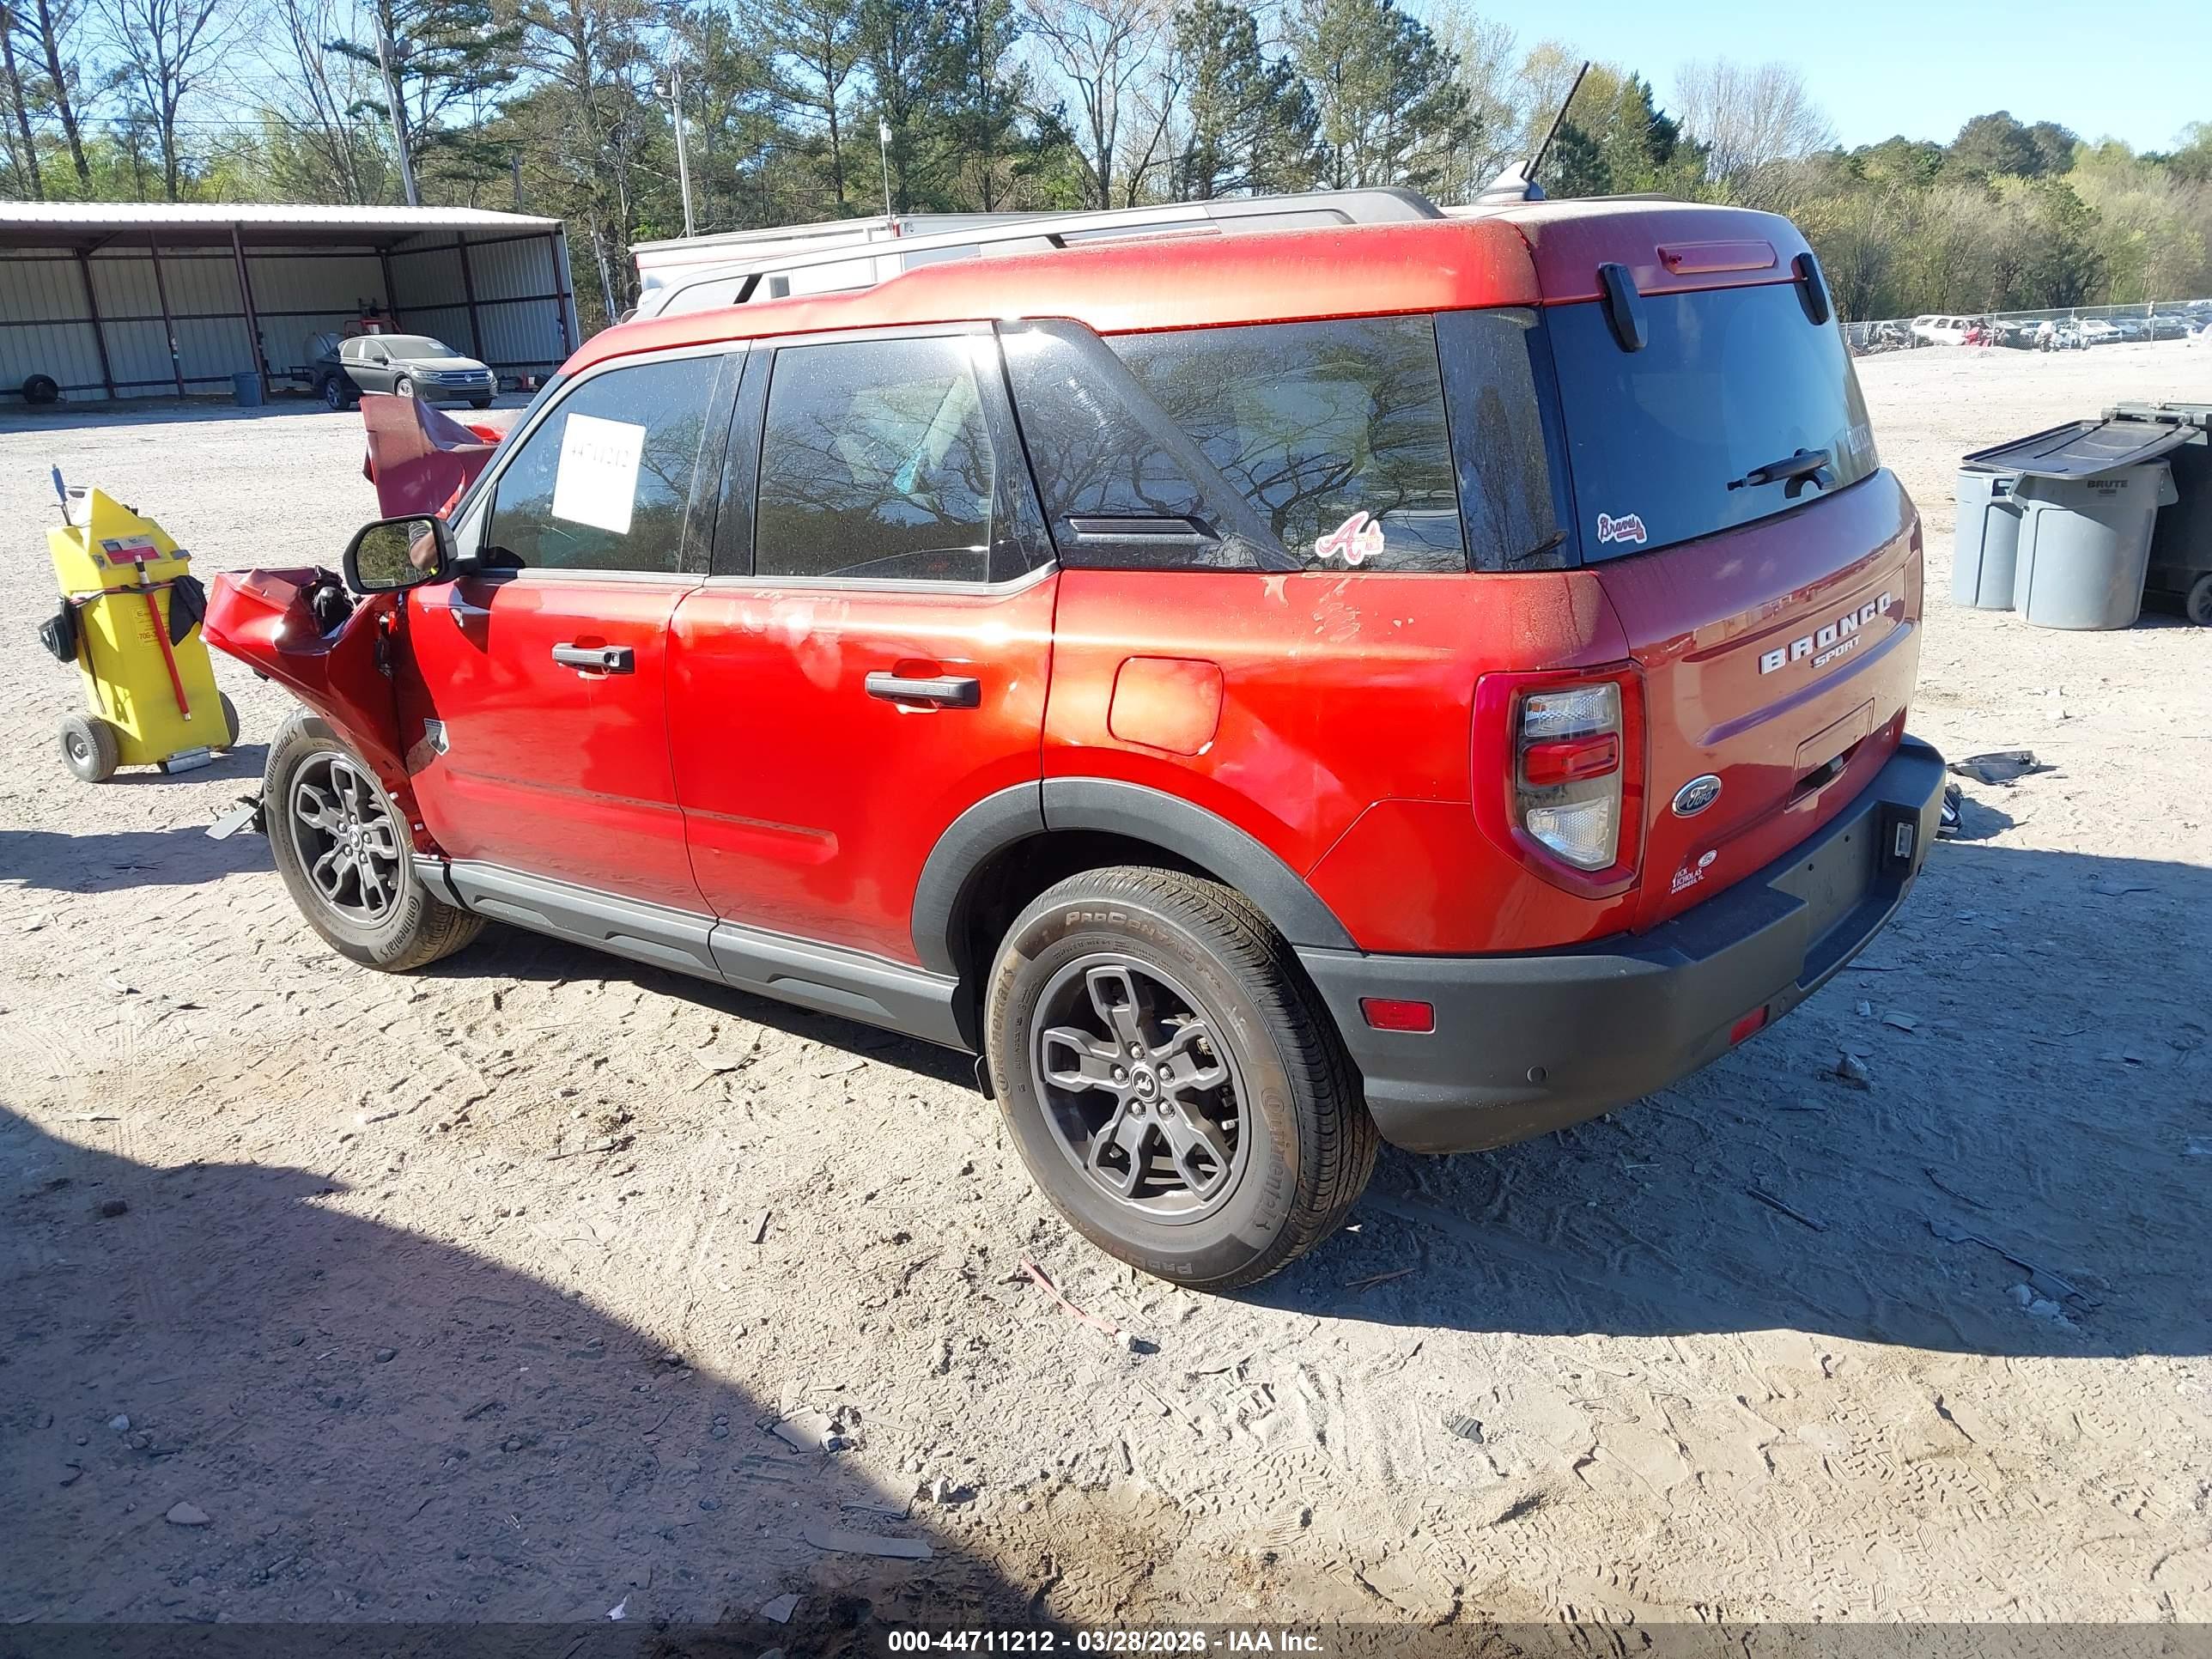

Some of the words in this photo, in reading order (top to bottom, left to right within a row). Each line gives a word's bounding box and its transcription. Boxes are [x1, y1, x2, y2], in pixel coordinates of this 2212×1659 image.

[2087, 479, 2129, 489] BRUTE
[1599, 515, 1637, 540] Braves
[1758, 591, 1892, 675] BRONCO
[1811, 634, 1862, 668] SPORT
[1686, 783, 1715, 809] Ford
